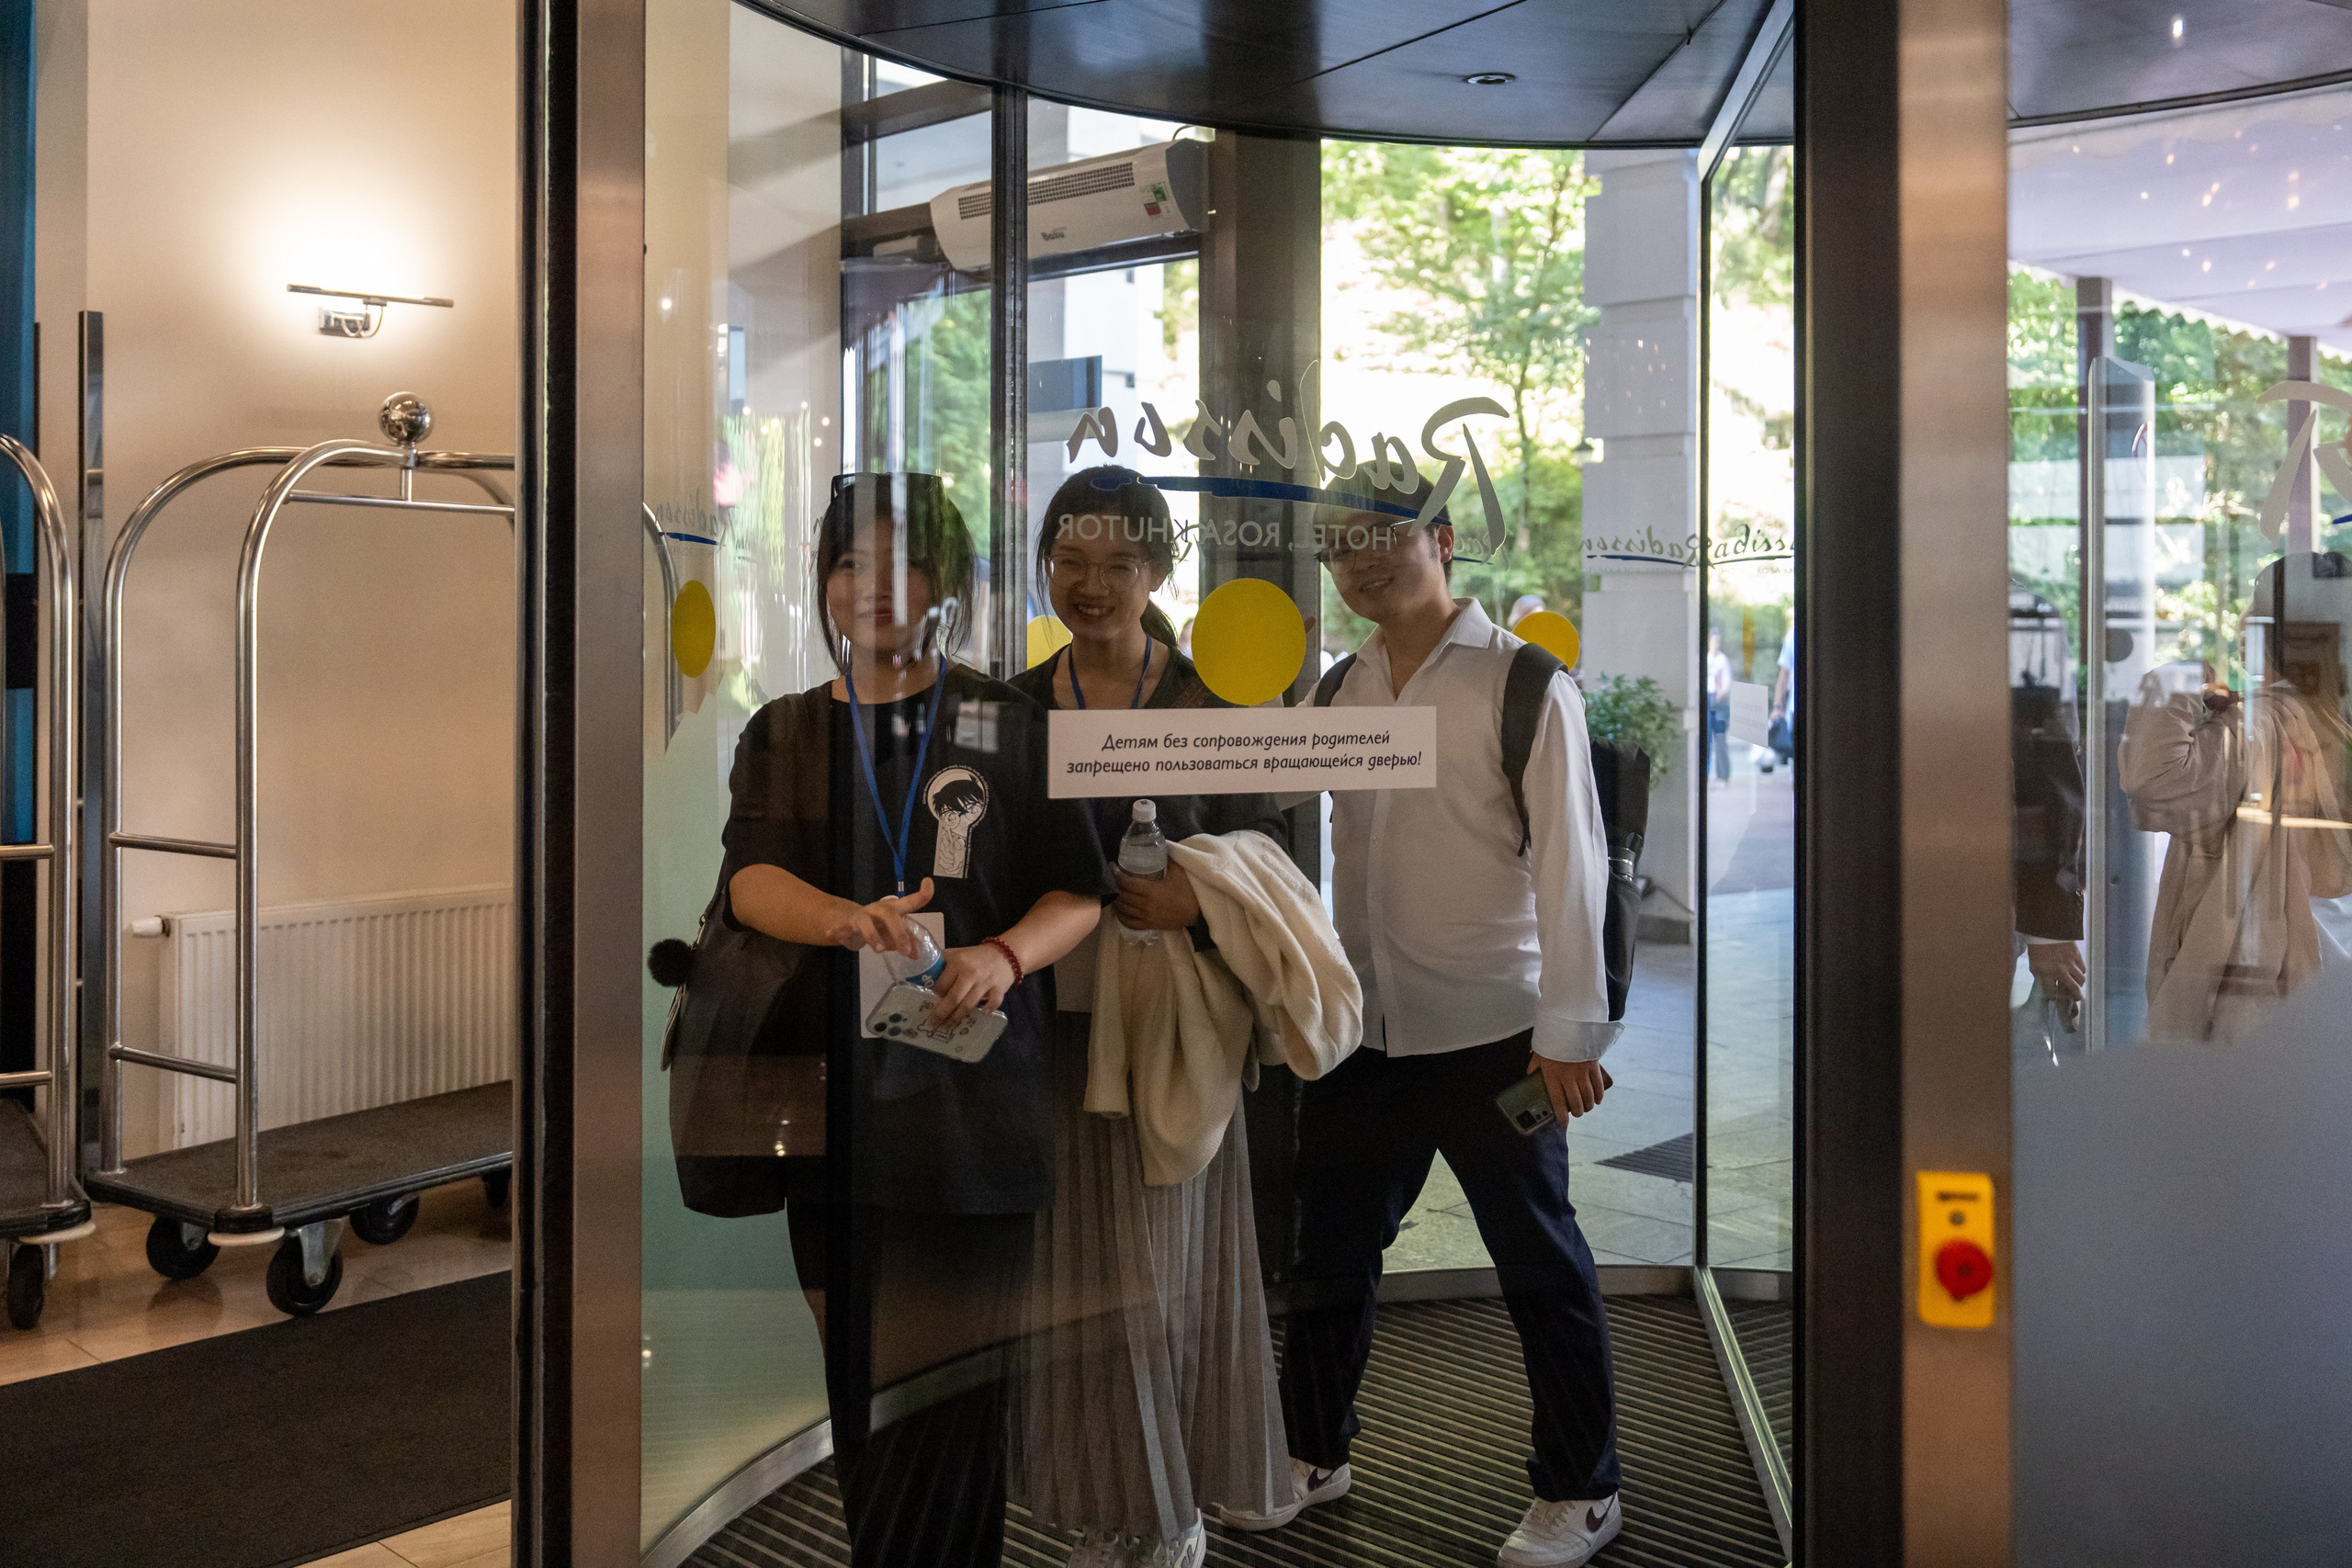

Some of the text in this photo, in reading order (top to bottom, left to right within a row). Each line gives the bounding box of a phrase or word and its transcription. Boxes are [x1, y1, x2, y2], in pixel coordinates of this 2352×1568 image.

[1707, 524, 1794, 570] adiss
[1102, 730, 1390, 751] Детям без сопровождения родителей
[1067, 751, 1422, 777] запрещено пользоваться вращающейся дверью!
